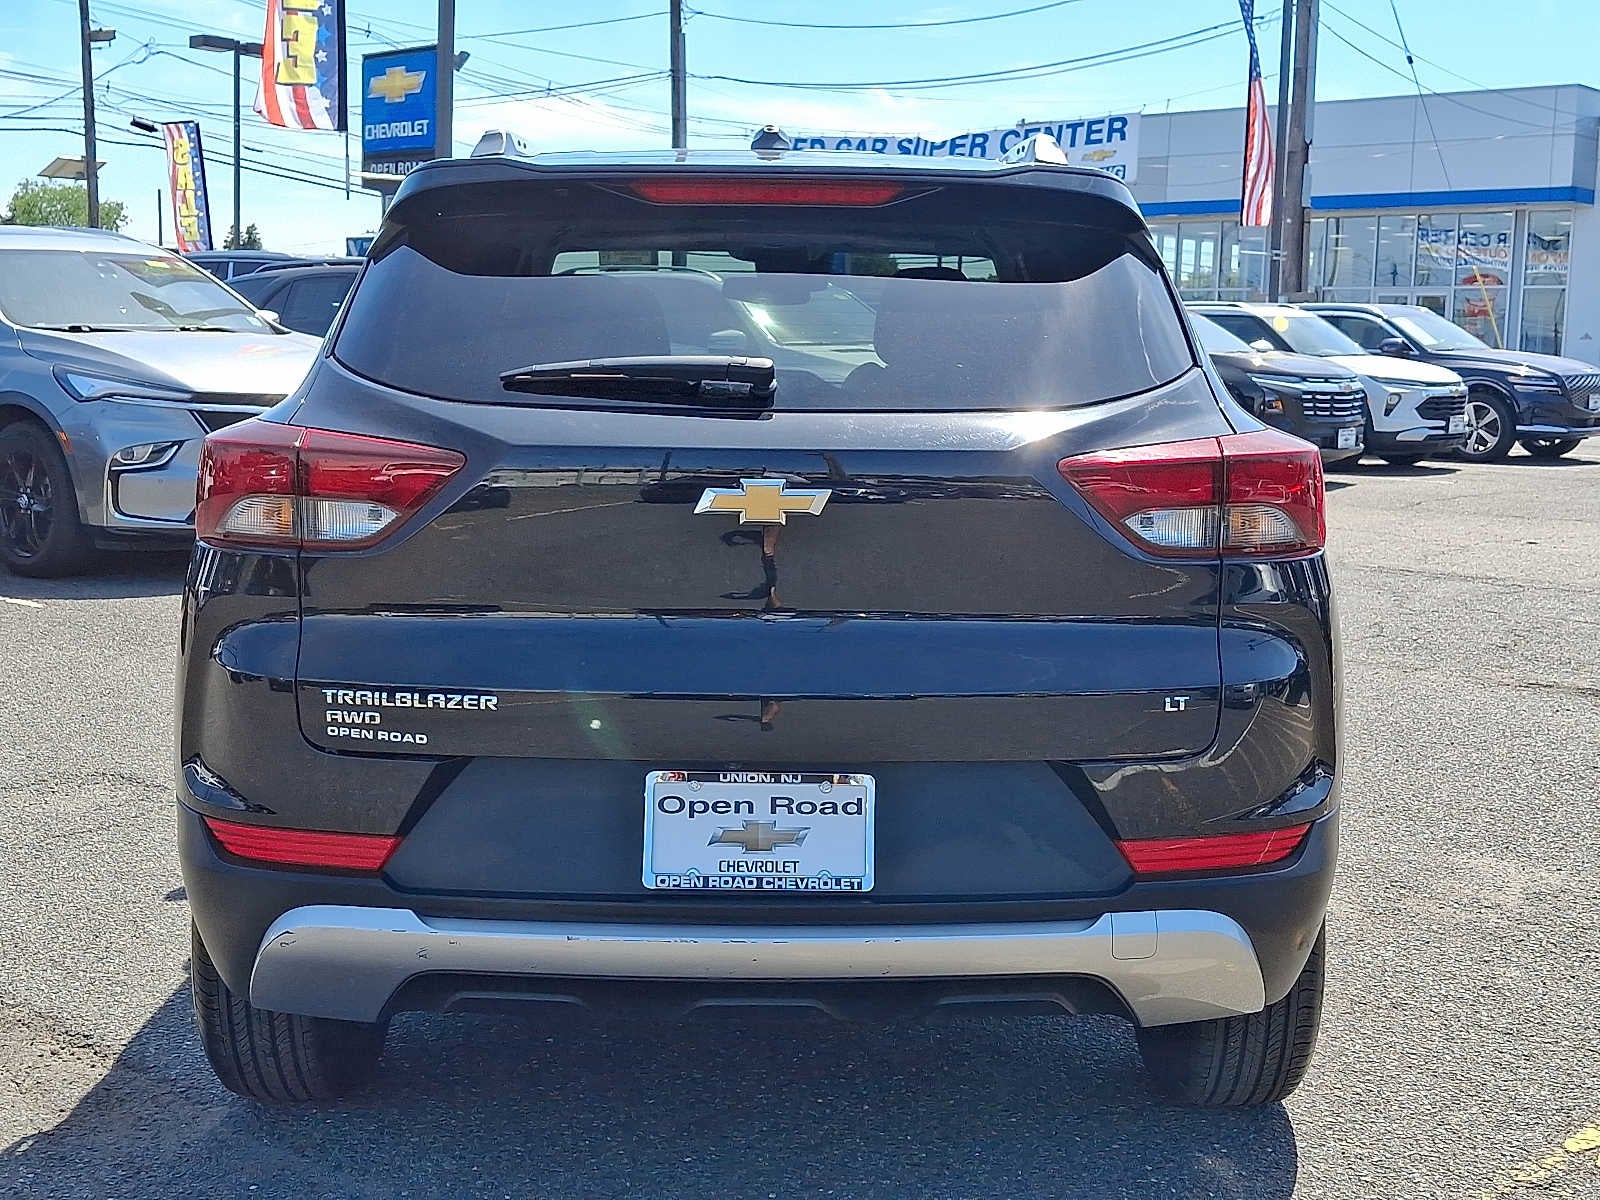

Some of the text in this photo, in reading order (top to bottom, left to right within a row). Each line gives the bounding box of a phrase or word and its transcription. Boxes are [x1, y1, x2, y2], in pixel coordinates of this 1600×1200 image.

[365, 119, 429, 139] CHEVROLET
[836, 138, 888, 154] CAR
[897, 132, 989, 158] SUPER
[370, 161, 424, 174] OPEN RO
[172, 138, 201, 242] SALE
[321, 689, 499, 711] TRAILBLAZER
[1164, 696, 1190, 711] LT
[326, 710, 382, 725] AWD
[327, 726, 428, 745] OPEN ROAD
[780, 774, 803, 784] NJ
[657, 795, 863, 819] Open Road
[718, 860, 800, 874] CHEVROLET
[656, 875, 863, 891] OPEN ROAD CHEVROLET
